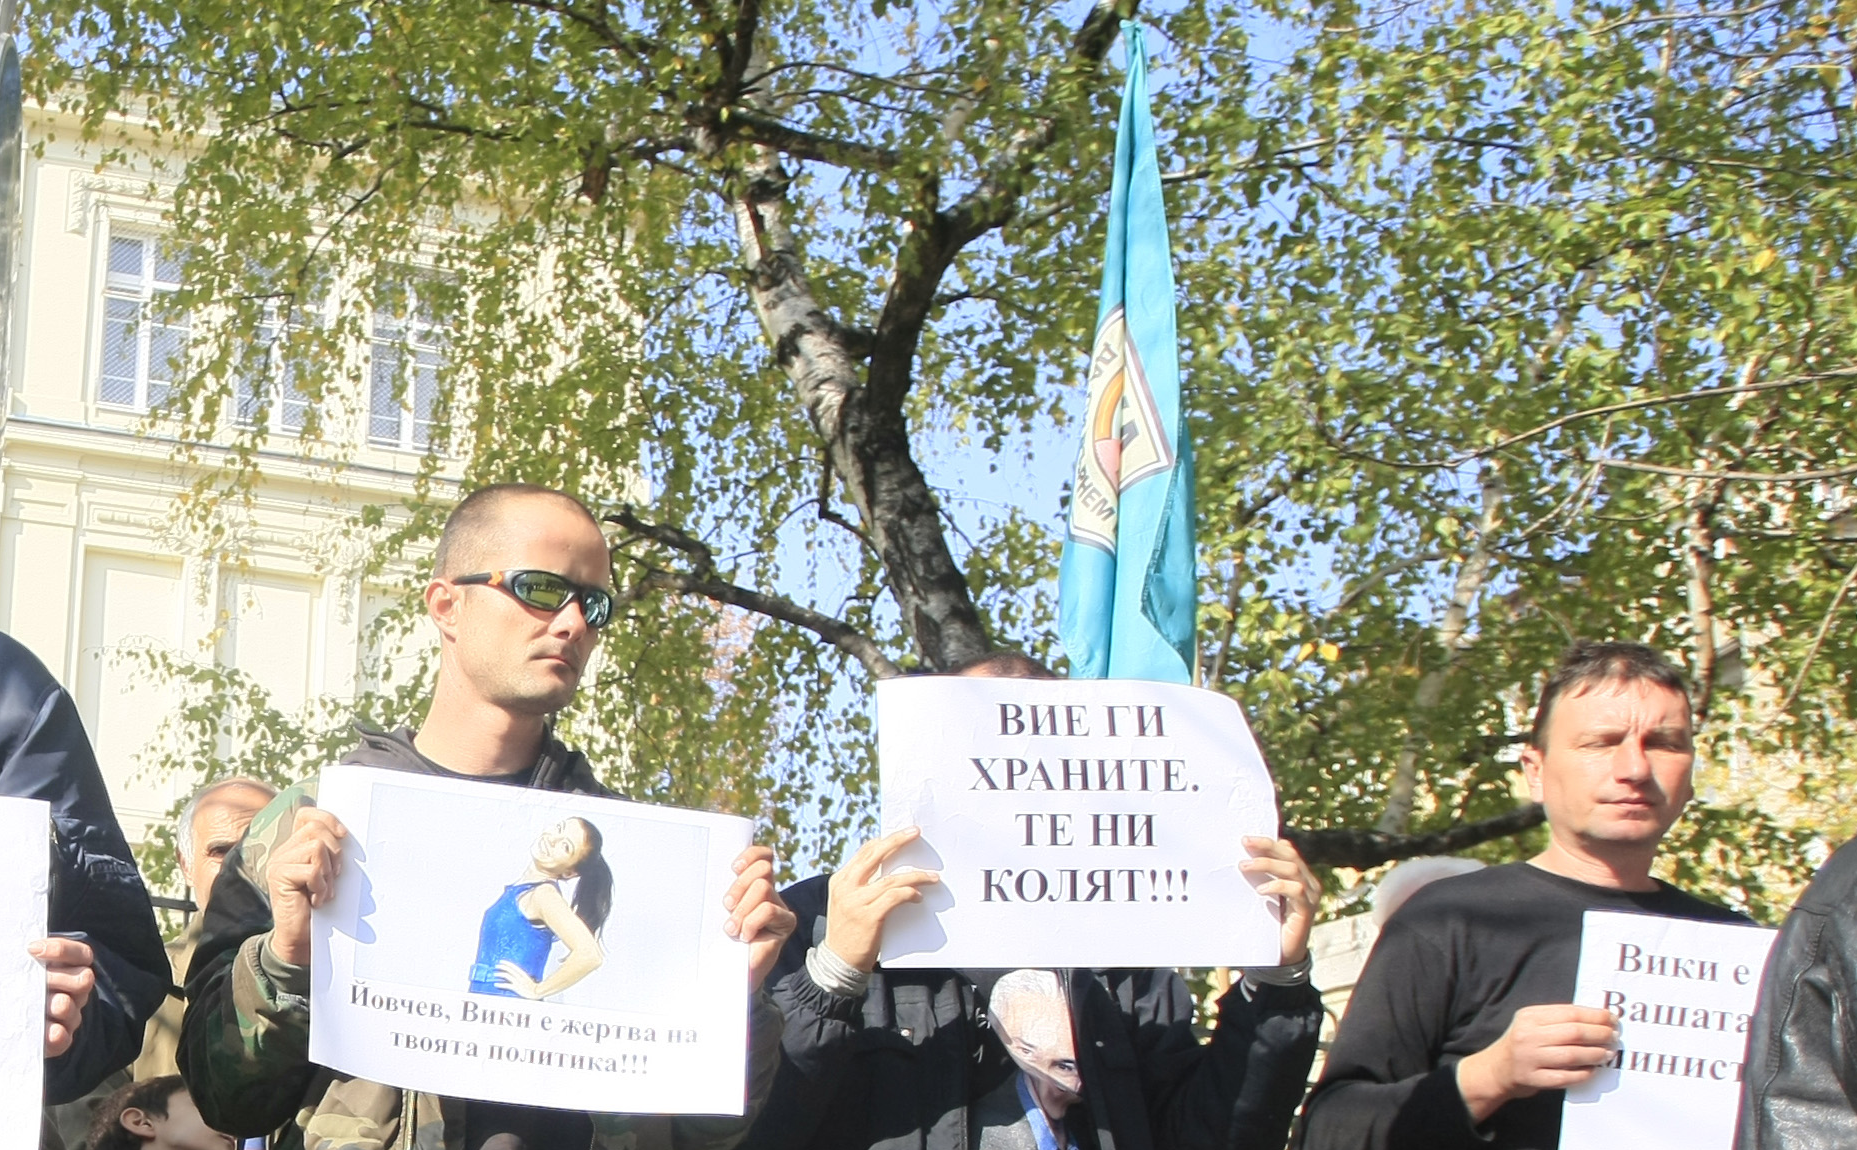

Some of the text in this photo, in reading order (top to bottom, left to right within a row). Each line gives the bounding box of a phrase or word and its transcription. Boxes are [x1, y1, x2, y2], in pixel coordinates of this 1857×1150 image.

[996, 702, 1168, 737] ВИЕ ГИ
[968, 757, 1199, 792] ХРАНИТЕ.
[1015, 813, 1158, 847] ТЕ НИ
[979, 868, 1189, 902] КОЛЯТ!!!
[1615, 942, 1751, 985] Вики е
[349, 980, 698, 1044] Йовчев, Вики е жертва на
[1602, 989, 1752, 1034] Вашата
[390, 1031, 648, 1075] твоята политика!!!
